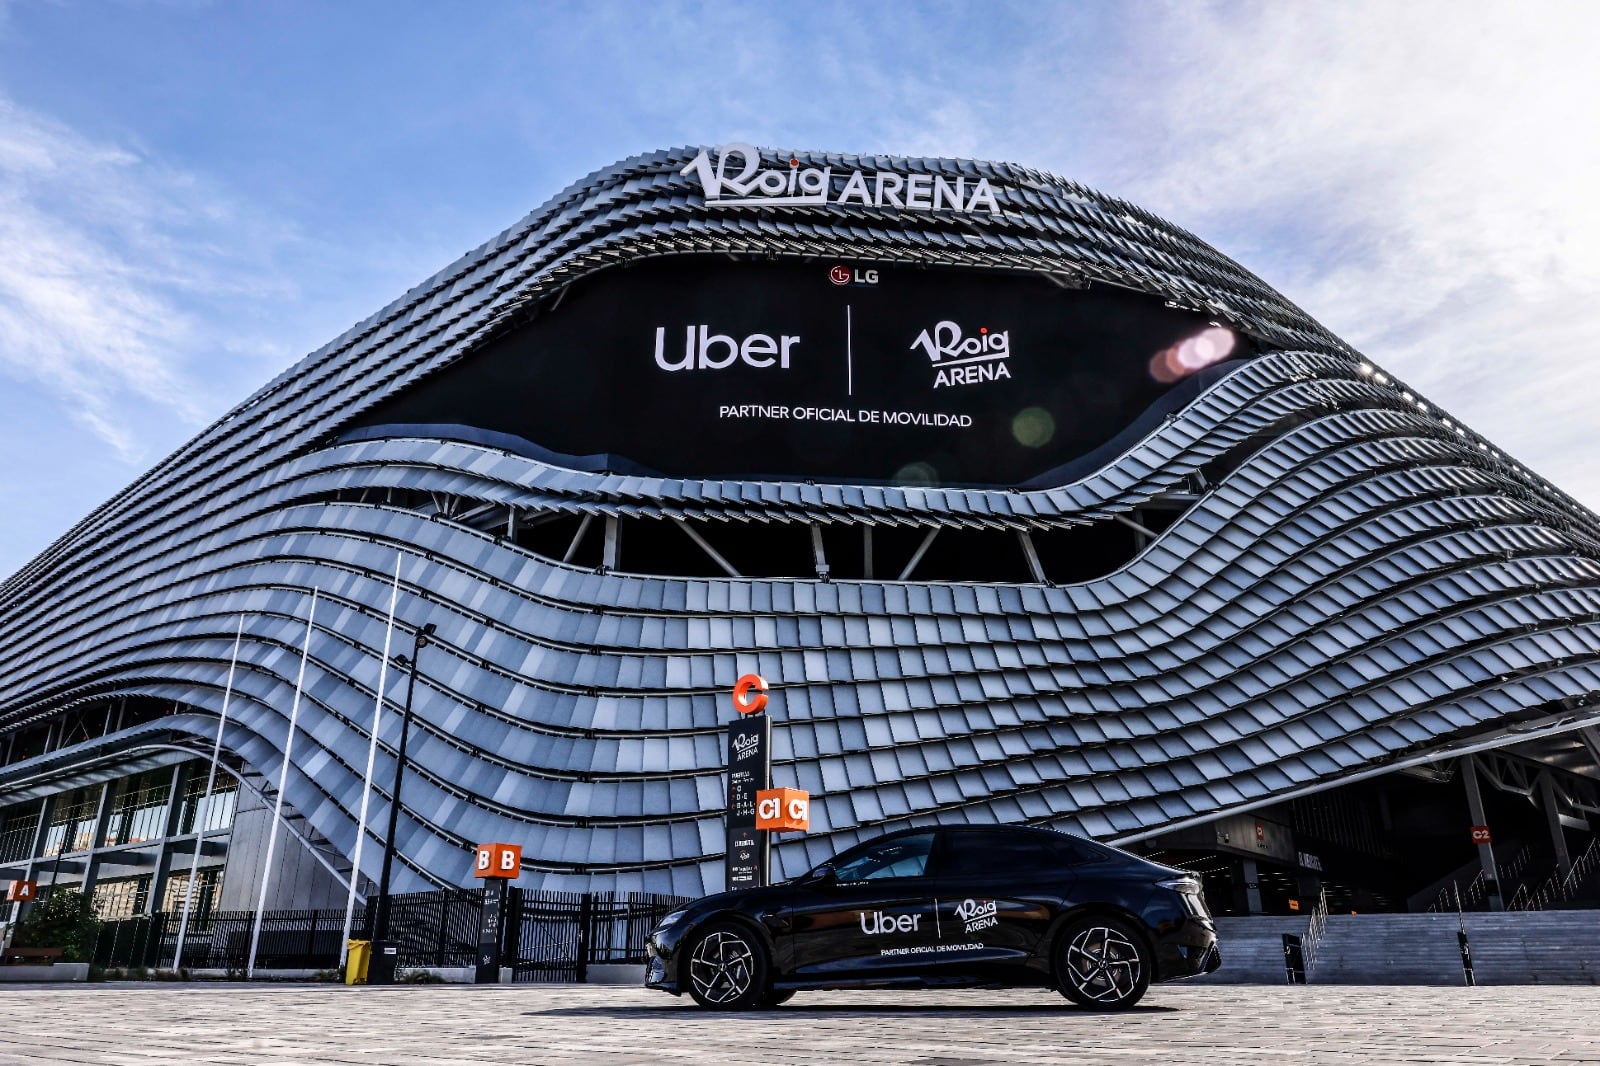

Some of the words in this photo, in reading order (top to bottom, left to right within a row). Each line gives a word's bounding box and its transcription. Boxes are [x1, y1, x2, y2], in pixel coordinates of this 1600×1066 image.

[680, 143, 832, 206] Roig
[836, 170, 1001, 215] ARENA
[854, 269, 879, 284] LG
[654, 324, 801, 371] Uber
[910, 320, 1010, 364] Roig
[933, 361, 1011, 388] ARENA
[719, 405, 789, 419] PARTNER
[793, 406, 855, 422] OFICIAL
[858, 409, 880, 423] DE
[883, 411, 972, 427] MOVILIDAD
[733, 673, 769, 715] C
[731, 733, 759, 751] Roig
[737, 746, 759, 762] ARENA
[1472, 830, 1490, 840] C2
[478, 850, 490, 870] B
[501, 850, 515, 870] B
[19, 884, 29, 896] A
[954, 899, 998, 921] Roig
[860, 911, 922, 934] Uber
[964, 916, 999, 934] ARENA
[880, 947, 910, 956] PARTNER
[910, 945, 936, 954] OFICIAL
[936, 945, 946, 953] DE
[946, 942, 984, 952] MOVILIDAD
